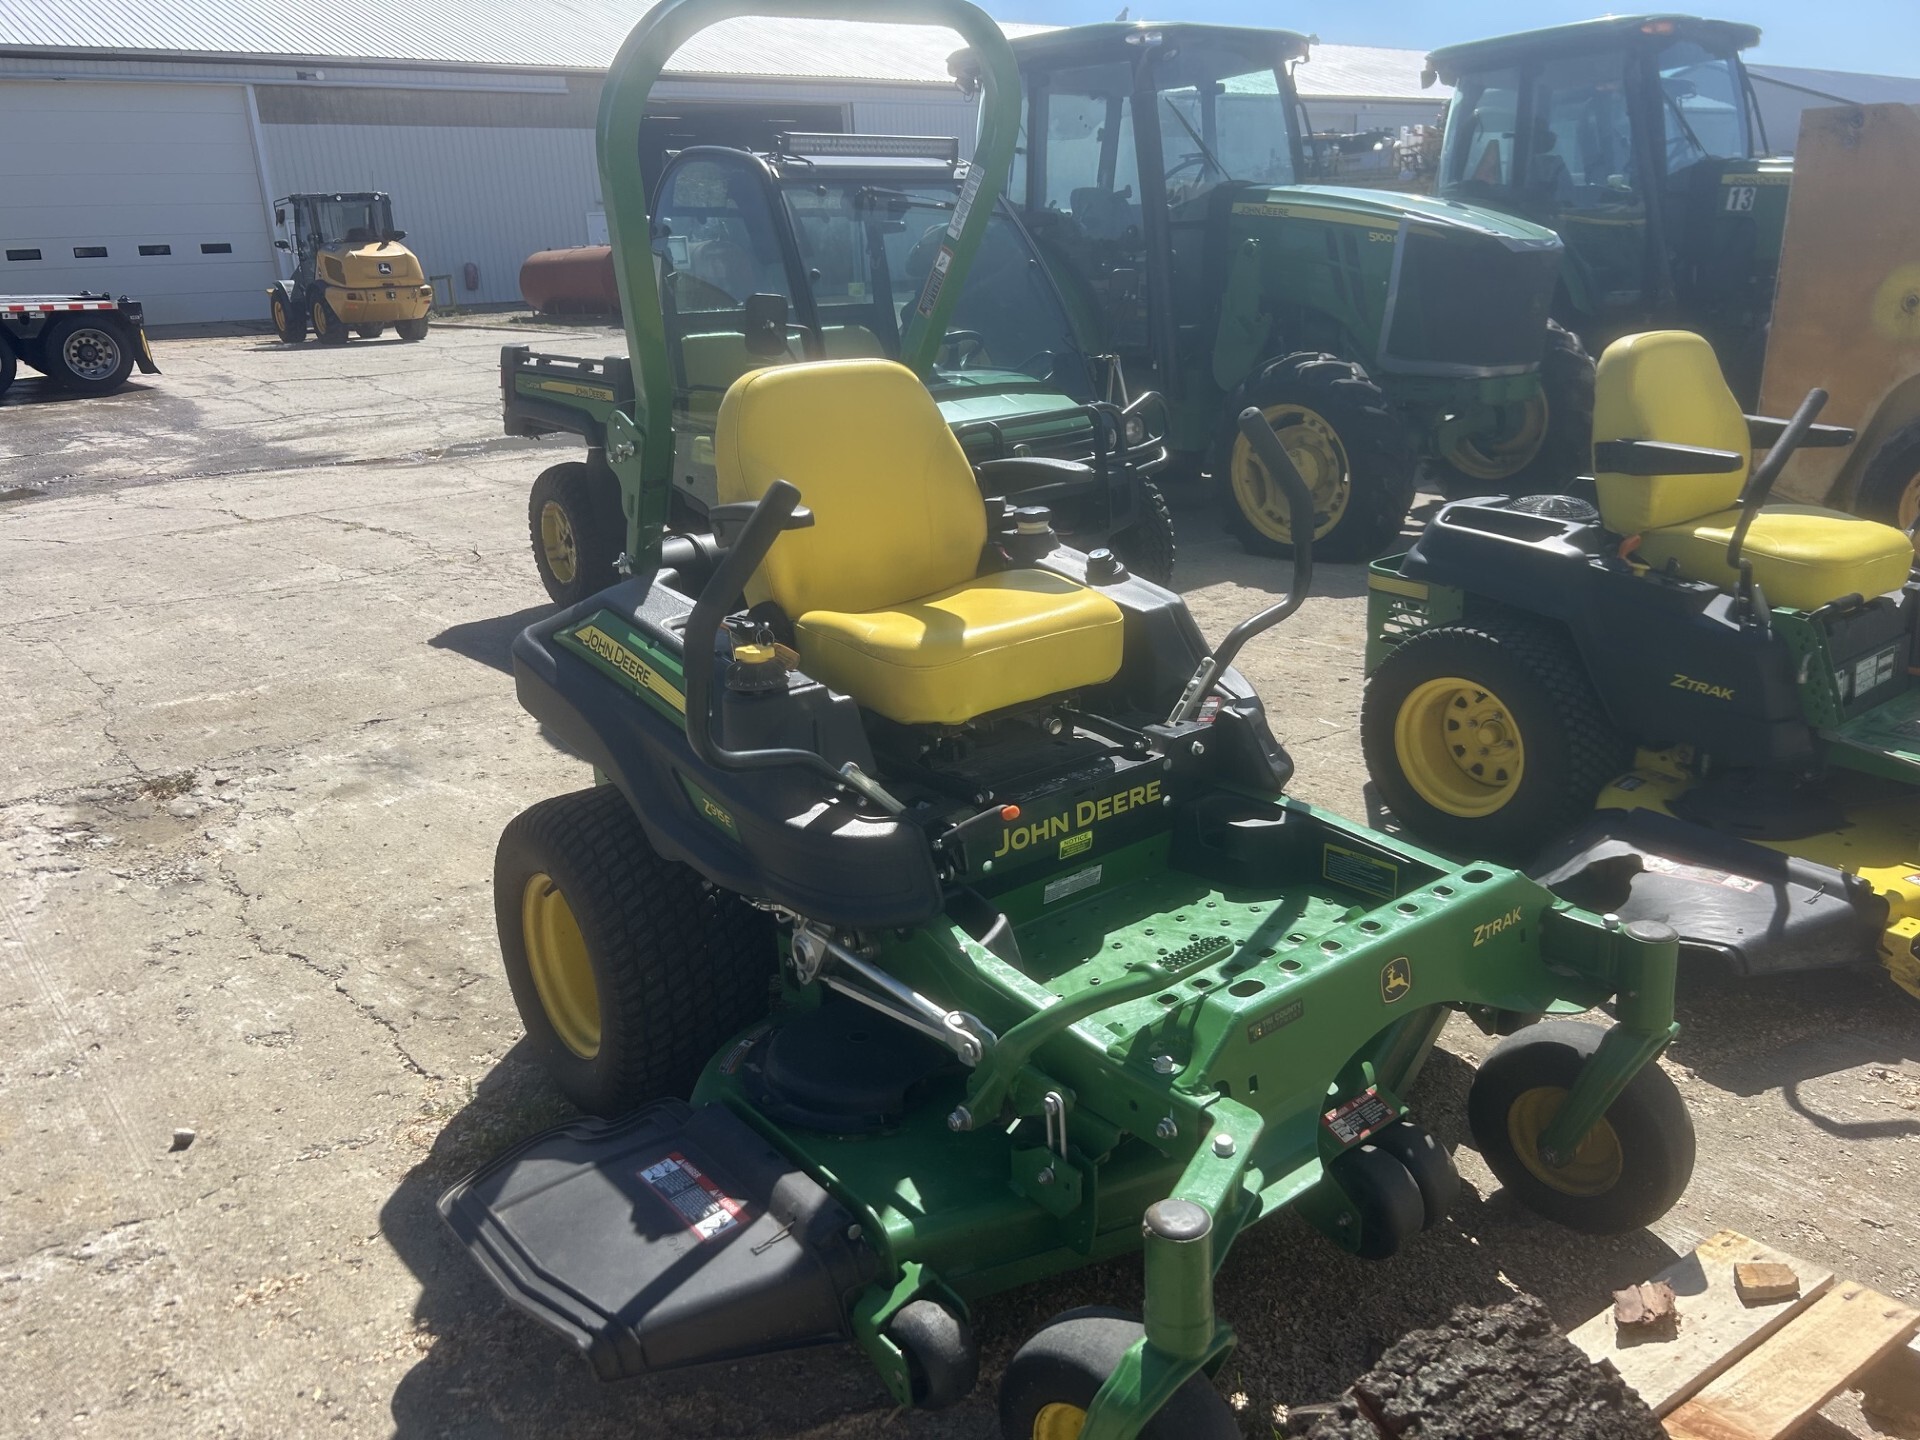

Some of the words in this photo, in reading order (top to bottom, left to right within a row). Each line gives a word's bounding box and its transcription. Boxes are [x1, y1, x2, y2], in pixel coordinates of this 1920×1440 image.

[1239, 205, 1263, 216] JOHN
[1262, 205, 1289, 217] DEERE
[1731, 187, 1755, 210] 13
[575, 387, 589, 397] JOHN
[588, 388, 608, 400] DEERE
[584, 629, 614, 662] JOHN
[613, 646, 651, 687] DEERE
[1669, 673, 1735, 700] ZTRAK
[995, 811, 1069, 857] JOHN
[1076, 779, 1161, 828] DEERE
[1063, 832, 1089, 846] NOTICE
[1473, 905, 1521, 947] ZTRAK
